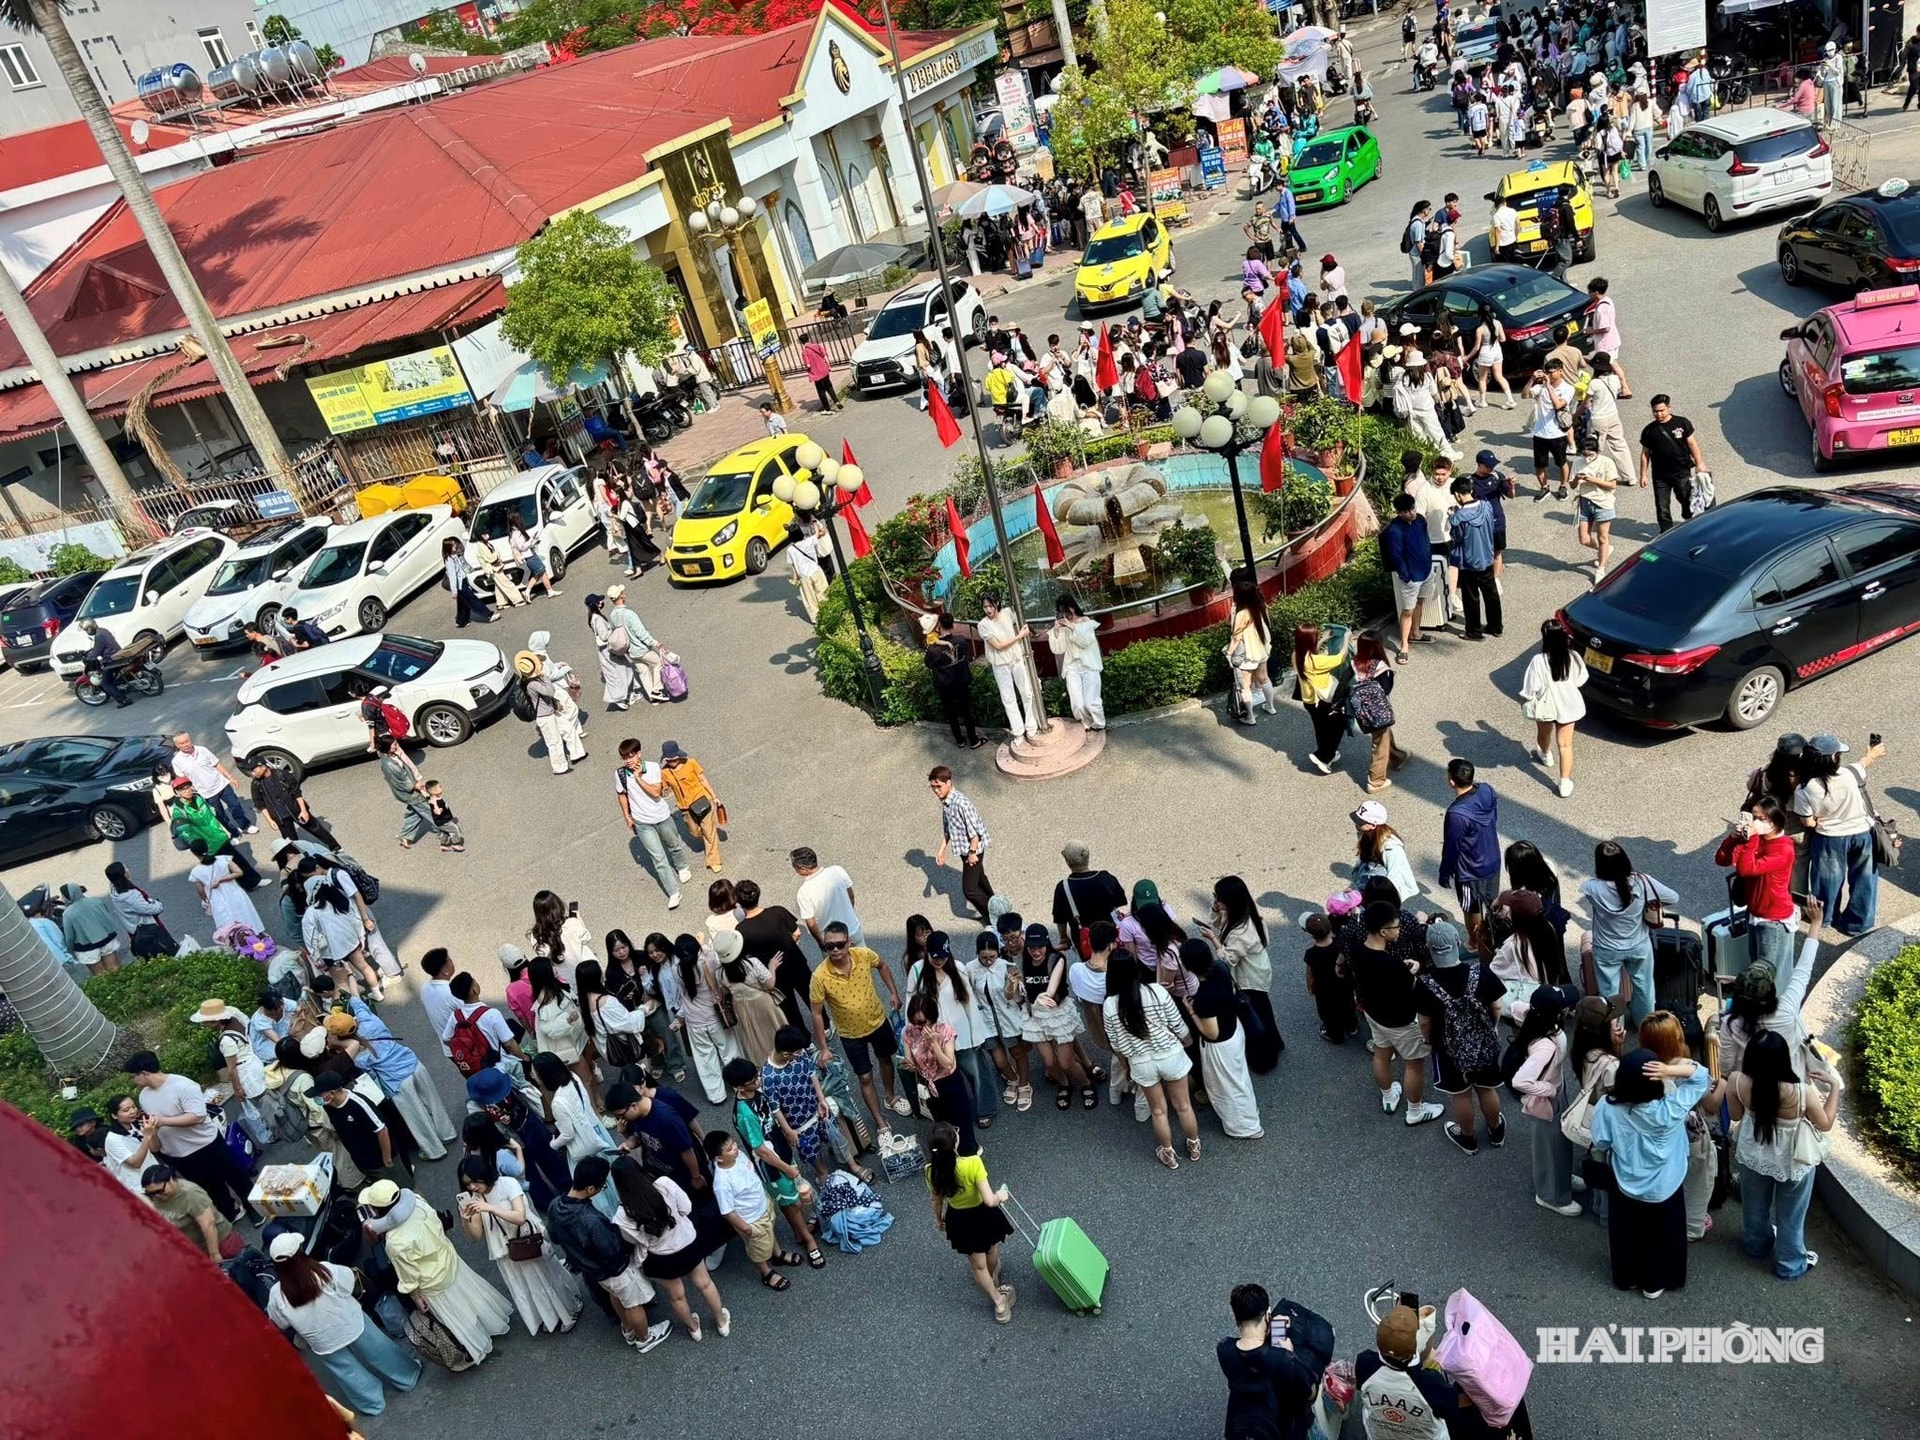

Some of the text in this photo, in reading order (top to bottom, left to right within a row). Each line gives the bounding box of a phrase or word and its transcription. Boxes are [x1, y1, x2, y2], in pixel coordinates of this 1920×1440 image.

[907, 51, 961, 92] PEERAGE
[1861, 296, 1876, 304] TAXI
[1366, 1391, 1424, 1417] LAAB
